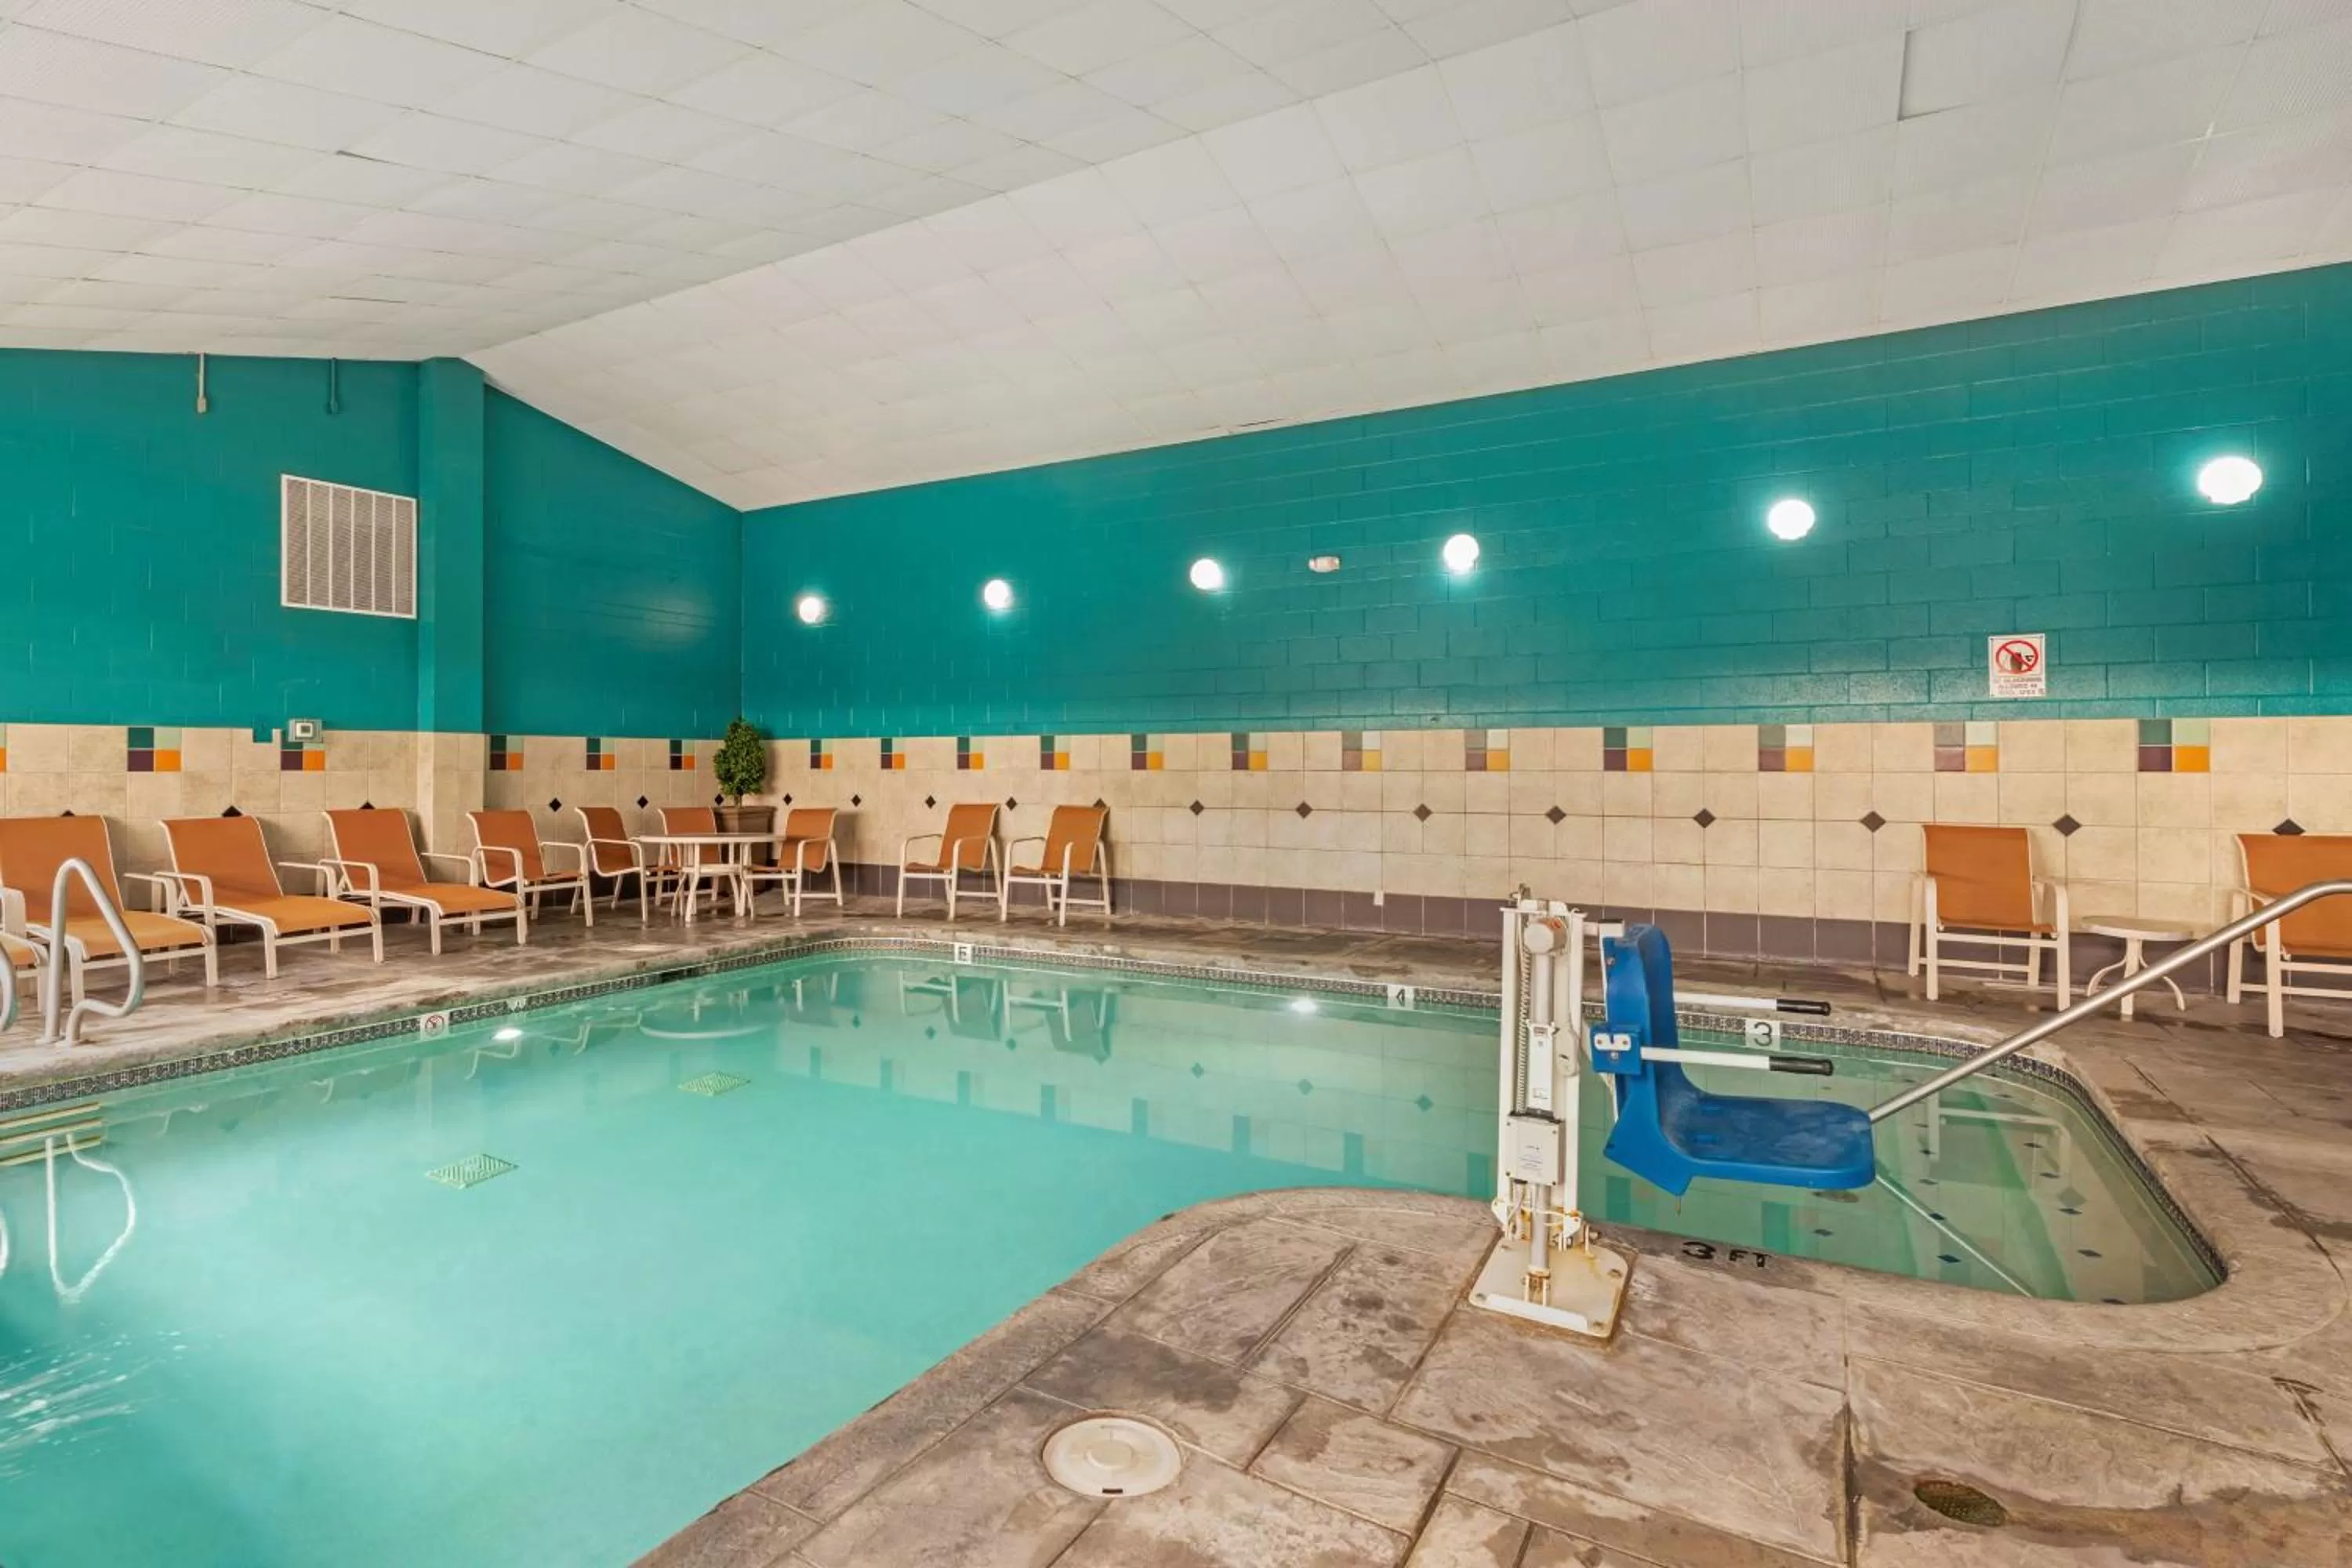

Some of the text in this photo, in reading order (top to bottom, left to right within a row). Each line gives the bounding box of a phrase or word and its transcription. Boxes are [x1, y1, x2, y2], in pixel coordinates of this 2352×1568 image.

[1754, 1022, 1773, 1047] 3
[1682, 1241, 1772, 1268] 3 FT
